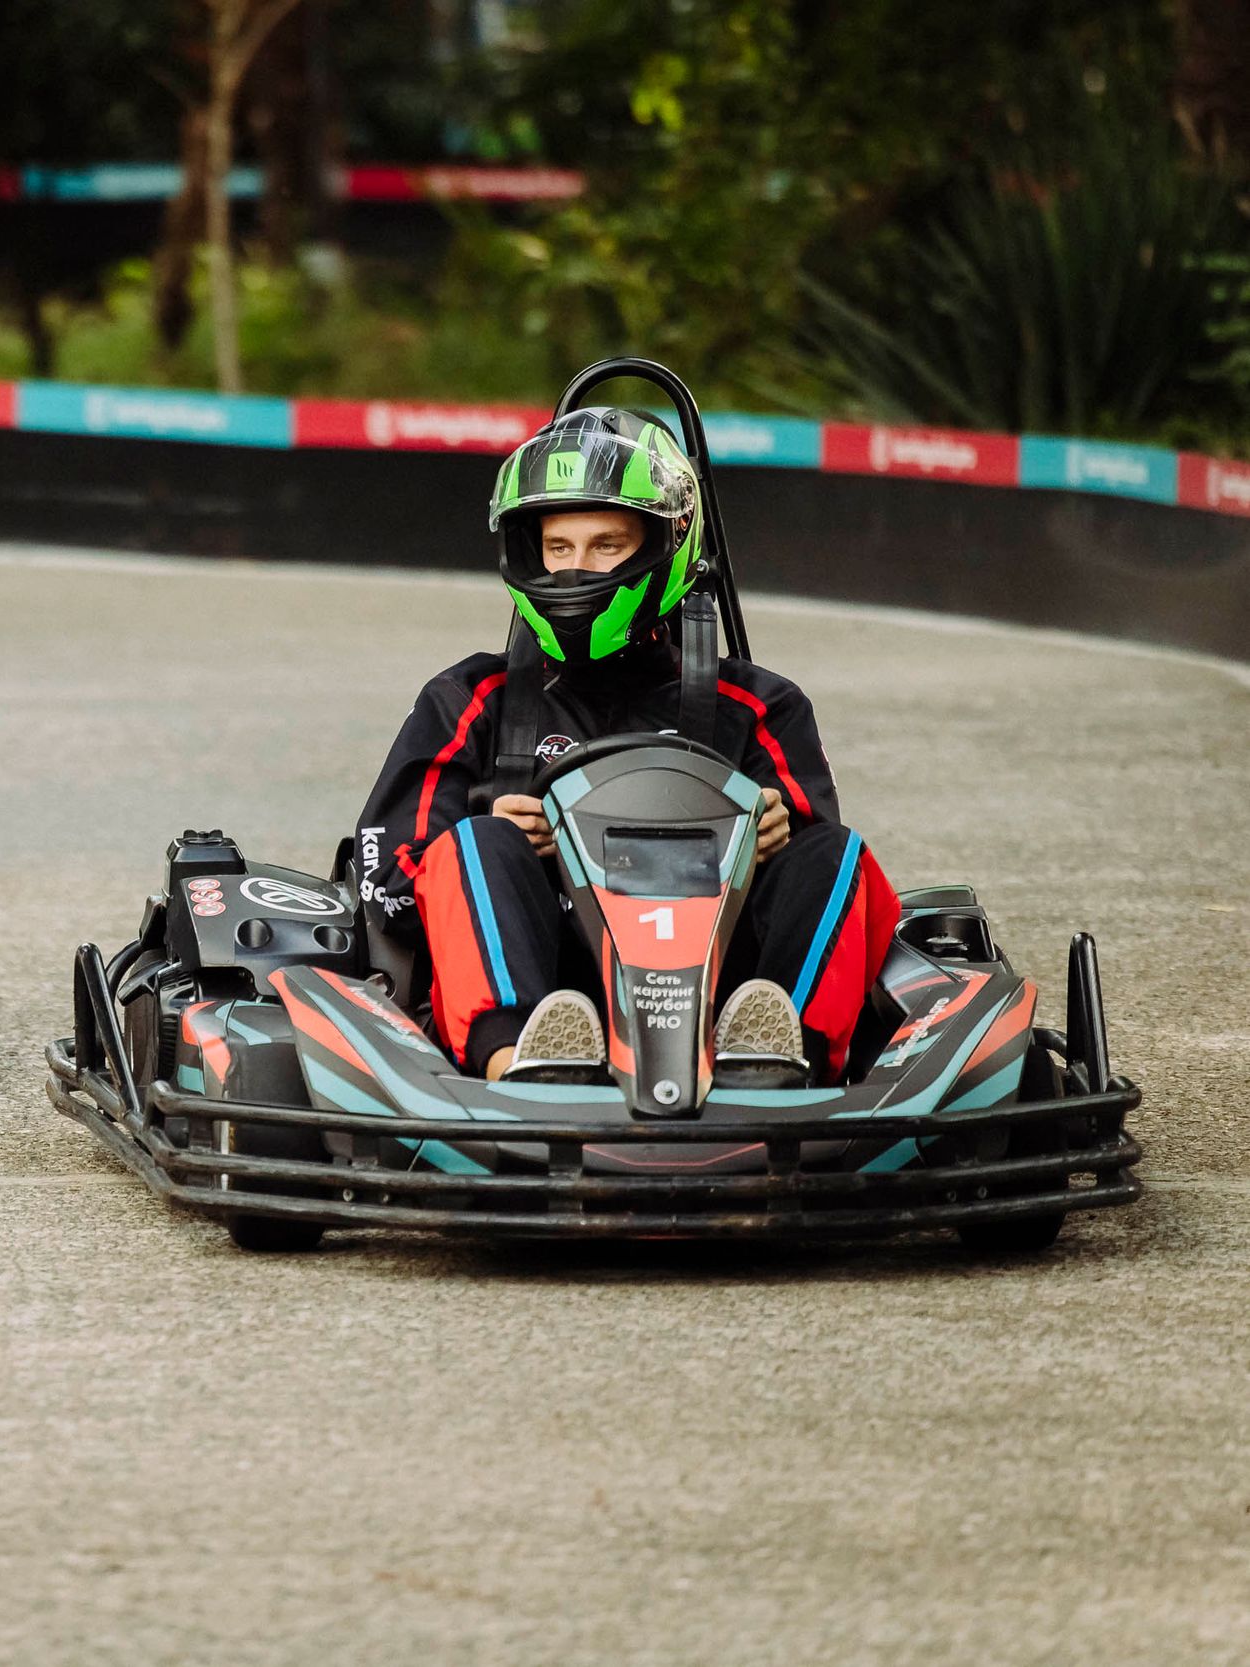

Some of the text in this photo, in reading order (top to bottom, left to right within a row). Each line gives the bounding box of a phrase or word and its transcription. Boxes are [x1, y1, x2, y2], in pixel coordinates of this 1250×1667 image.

[638, 907, 674, 940] 1
[645, 972, 682, 985] Сеть
[633, 985, 695, 1000] картинг
[636, 998, 693, 1014] клубов
[647, 1014, 681, 1029] PRO
